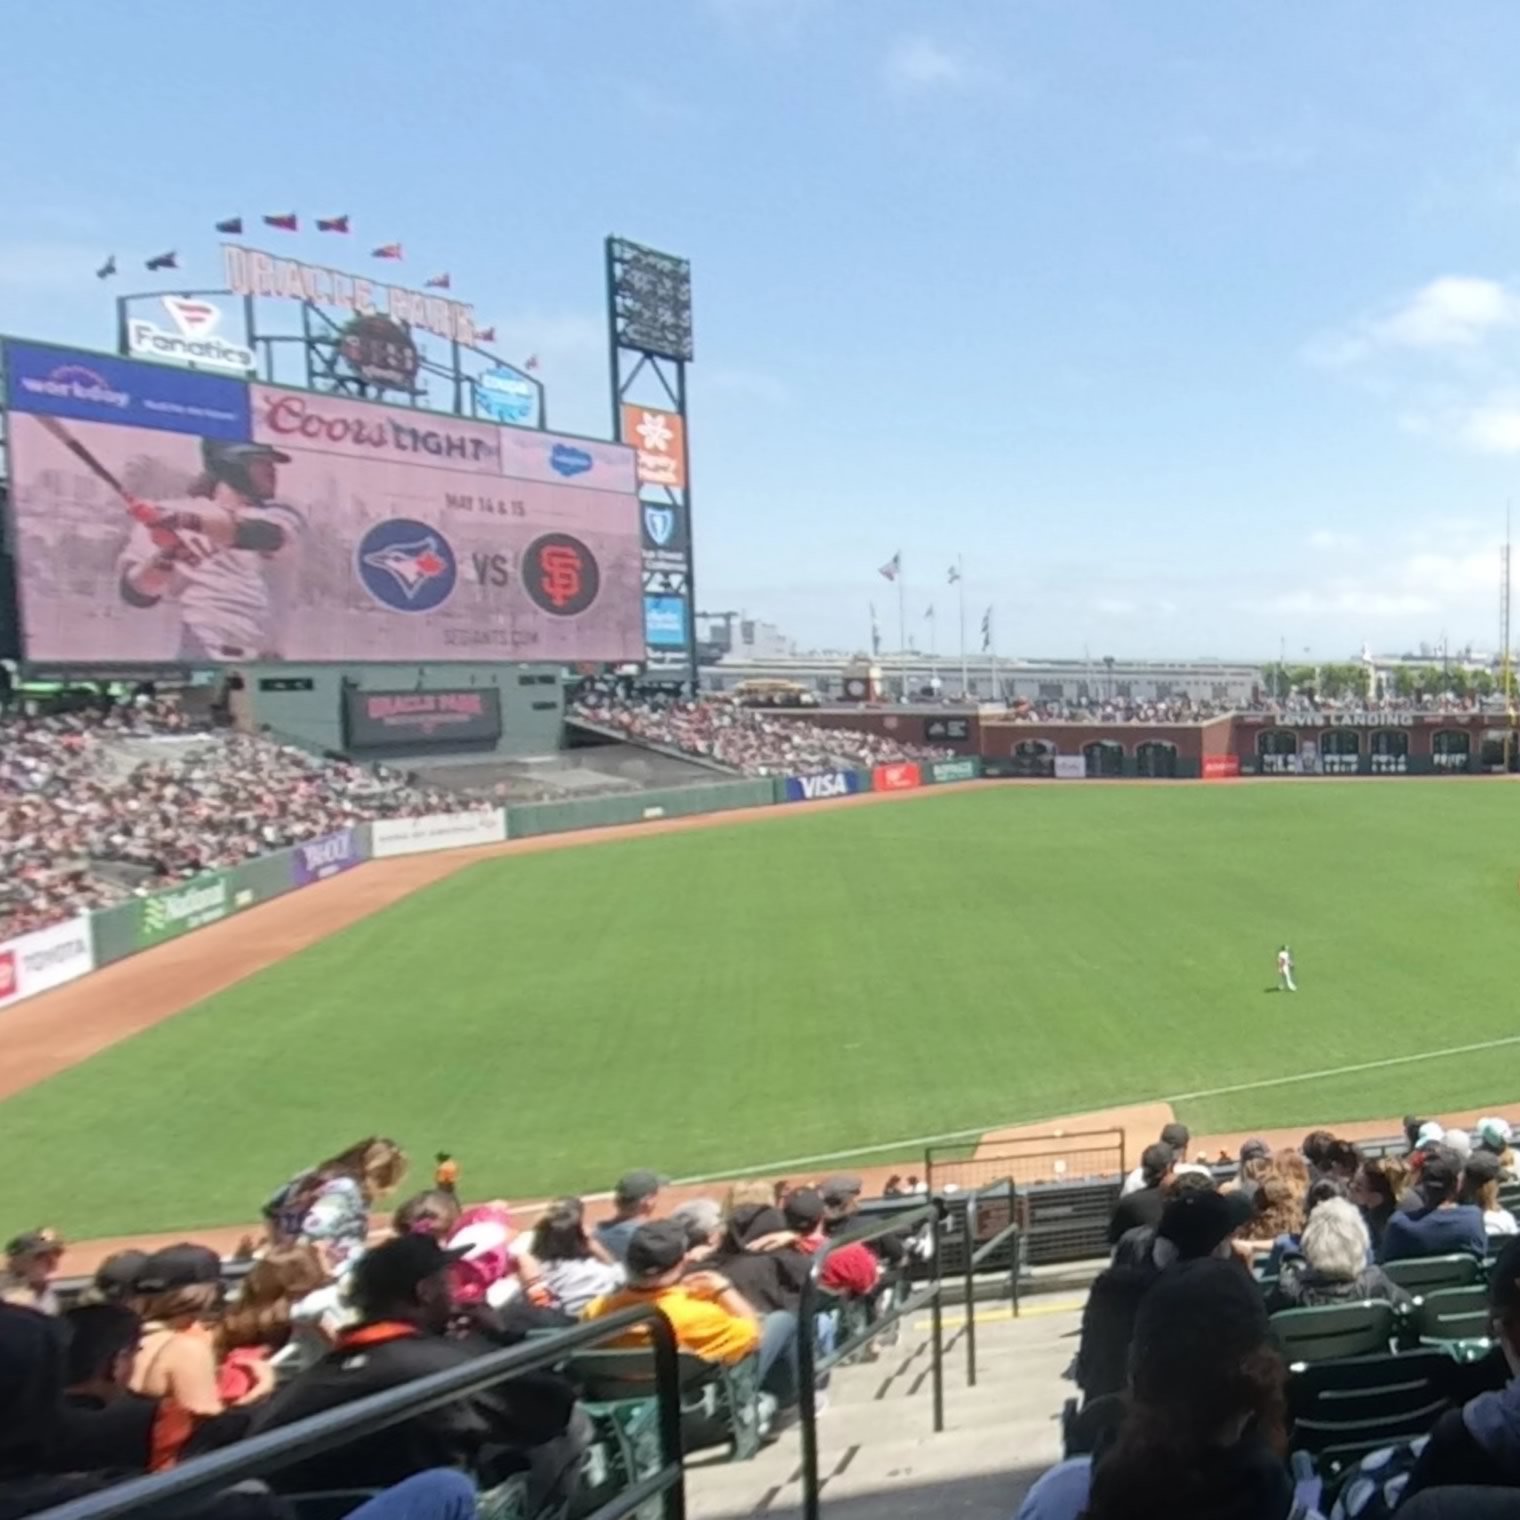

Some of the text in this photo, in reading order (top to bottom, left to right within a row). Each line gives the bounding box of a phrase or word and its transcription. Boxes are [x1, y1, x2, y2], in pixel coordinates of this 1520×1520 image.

[134, 324, 251, 365] Fanatics
[264, 394, 389, 447] Coors
[389, 417, 484, 460] LIGHT
[471, 552, 509, 587] VS
[1330, 711, 1414, 727] LANDING
[799, 773, 848, 799] VISA
[23, 939, 86, 971] TOYOTA
